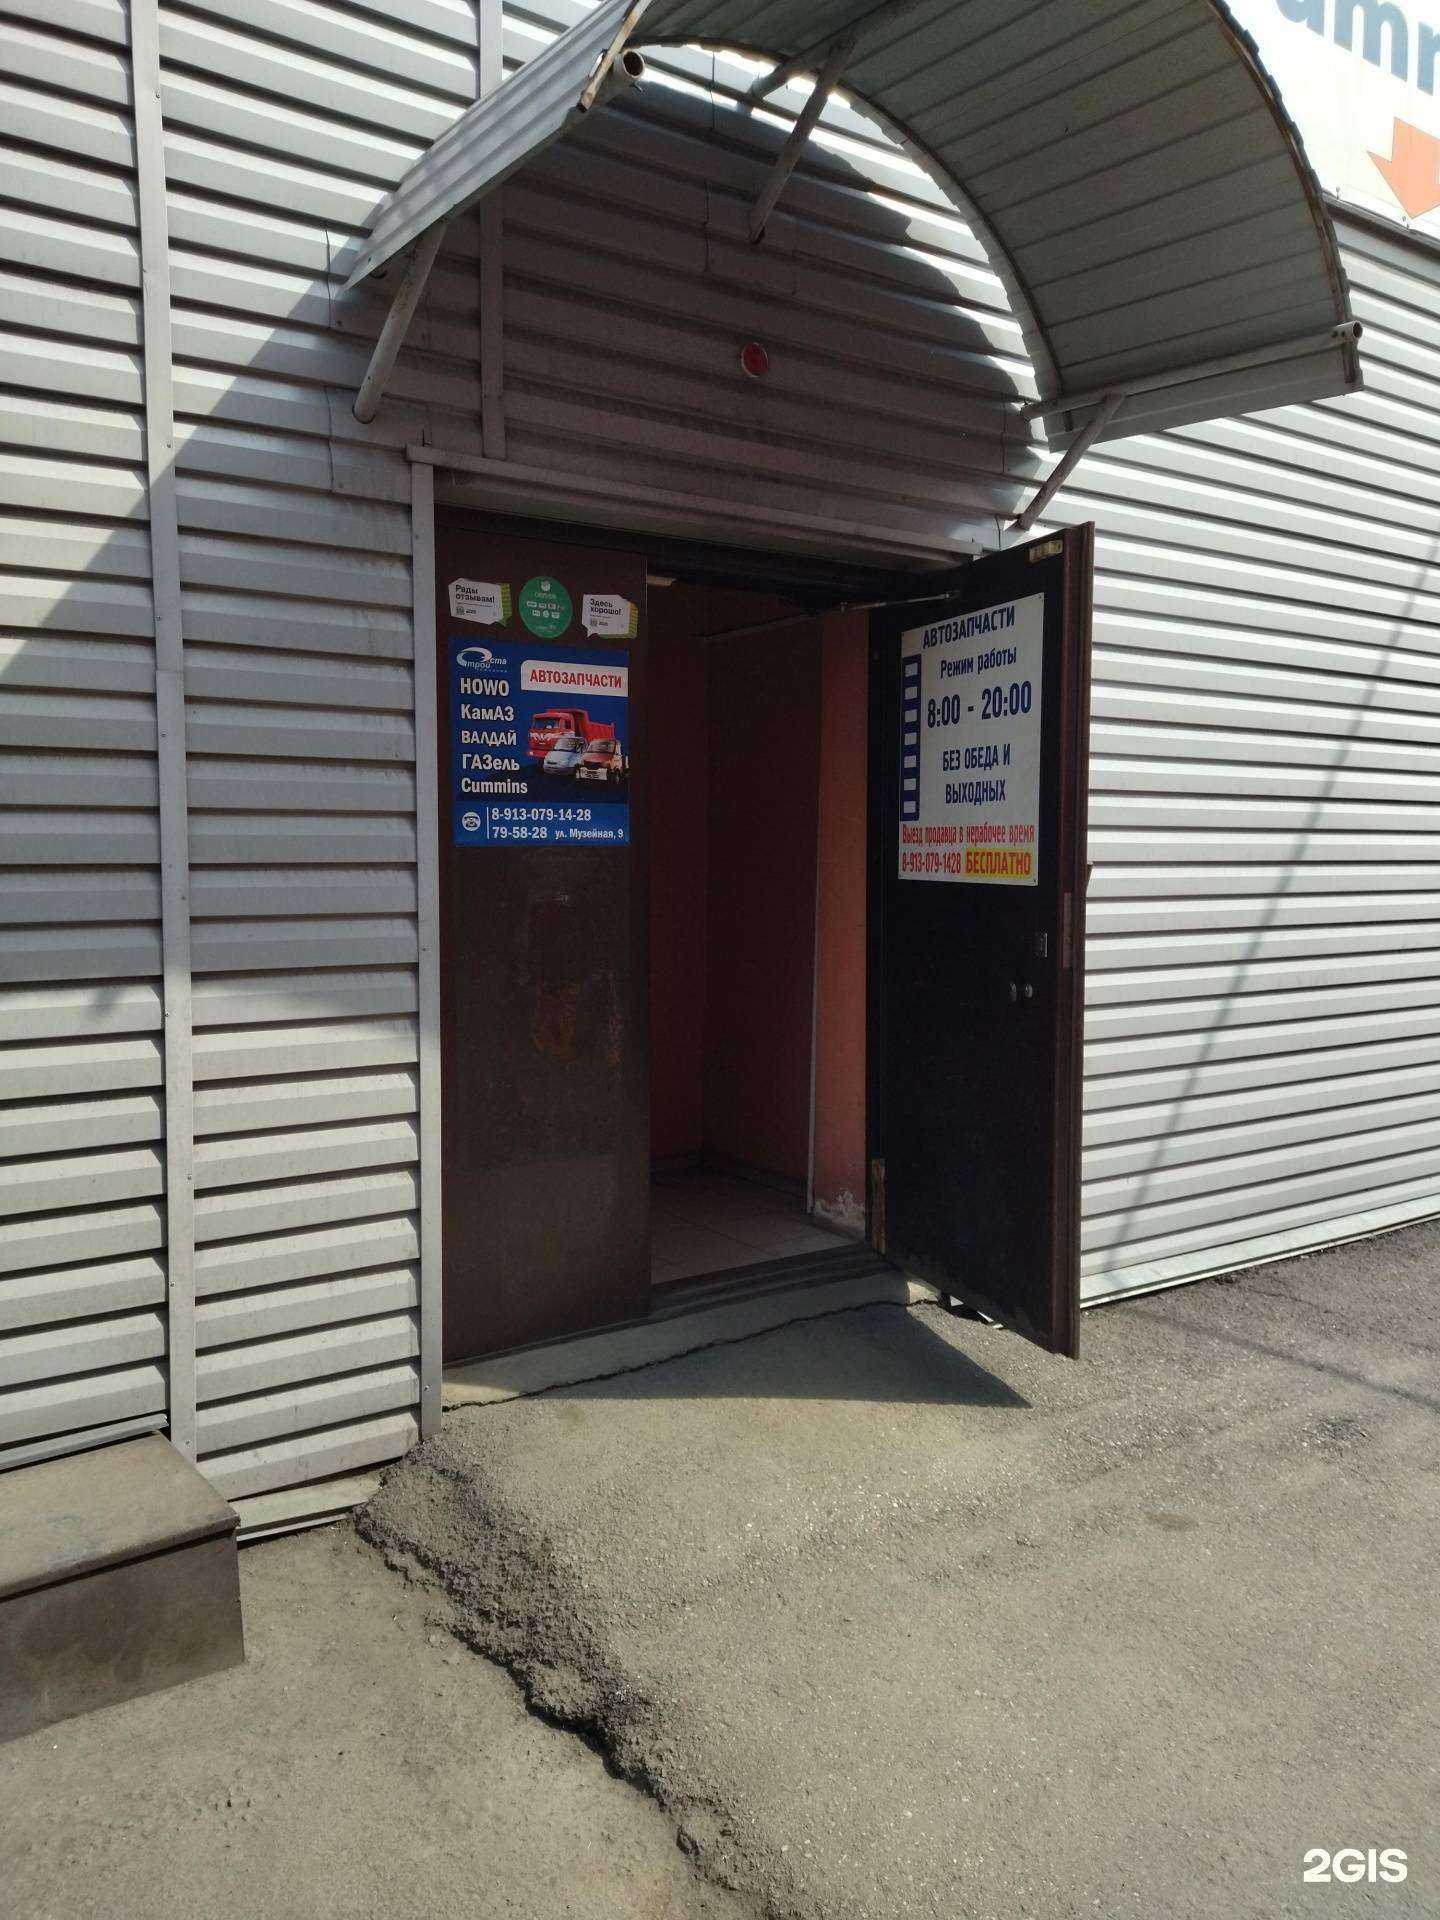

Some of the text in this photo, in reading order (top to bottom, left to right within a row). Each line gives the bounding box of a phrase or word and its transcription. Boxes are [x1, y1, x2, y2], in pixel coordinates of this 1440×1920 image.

[455, 584, 478, 595] Рады
[455, 593, 495, 604] отзывам!
[590, 598, 613, 608] Здесь
[590, 606, 622, 616] хорошо!
[922, 605, 1015, 649] АВТОЗАПЧАСТИ
[940, 647, 1017, 679] Режим работы
[460, 677, 510, 697] HOWO
[529, 669, 622, 688] АВТОЗАПЧАСТИ
[460, 703, 515, 722] КамАЗ
[927, 694, 961, 728] 8:00
[981, 681, 1032, 720] 20:00
[461, 729, 517, 747] ВАЛДАЙ
[461, 753, 520, 771] ГАЗель
[942, 743, 1011, 772] БЕЗ ОБЕДА И
[461, 777, 528, 794] Cummins
[945, 780, 1006, 805] ВЫХОДНЫХ
[491, 807, 592, 821] 8-913-079-14-28
[491, 826, 624, 840] 79-58-28 ул. Музейная, 9
[902, 822, 1035, 847] Выезд продавца в нерабочее время
[902, 851, 1032, 876] 8-913-079-1428 БЕСПЛАТНО
